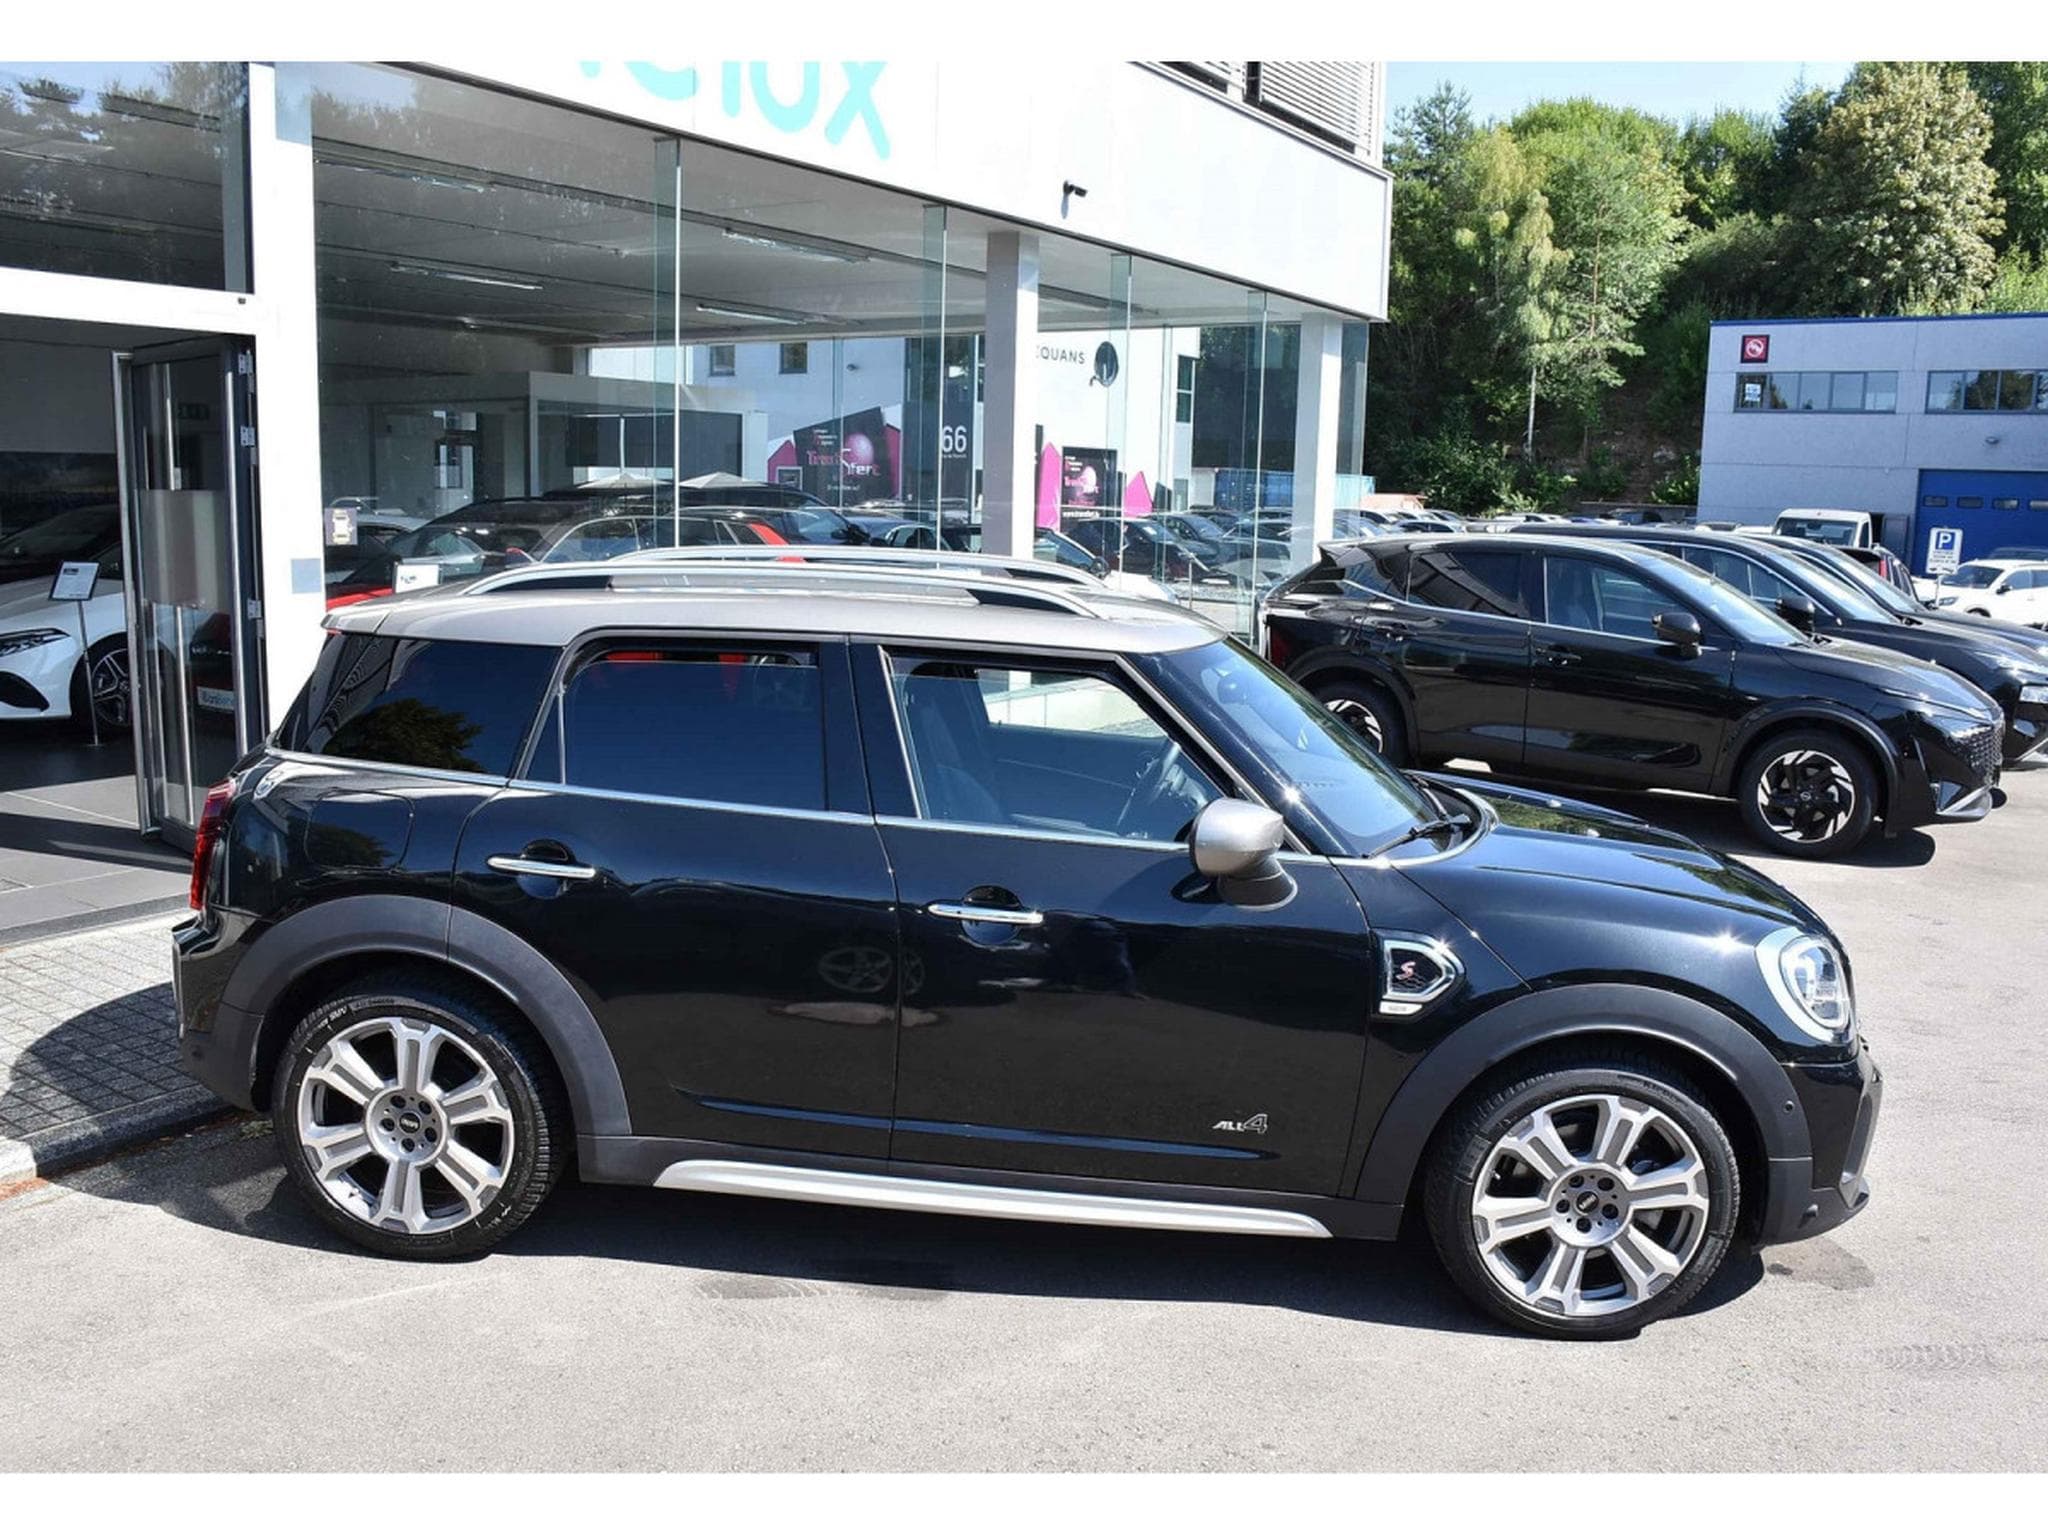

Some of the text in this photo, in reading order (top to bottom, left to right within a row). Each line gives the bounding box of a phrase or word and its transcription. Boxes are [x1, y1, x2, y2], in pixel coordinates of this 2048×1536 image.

[942, 425, 967, 452] 66
[1938, 532, 1952, 549] P
[1396, 961, 1416, 980] S
